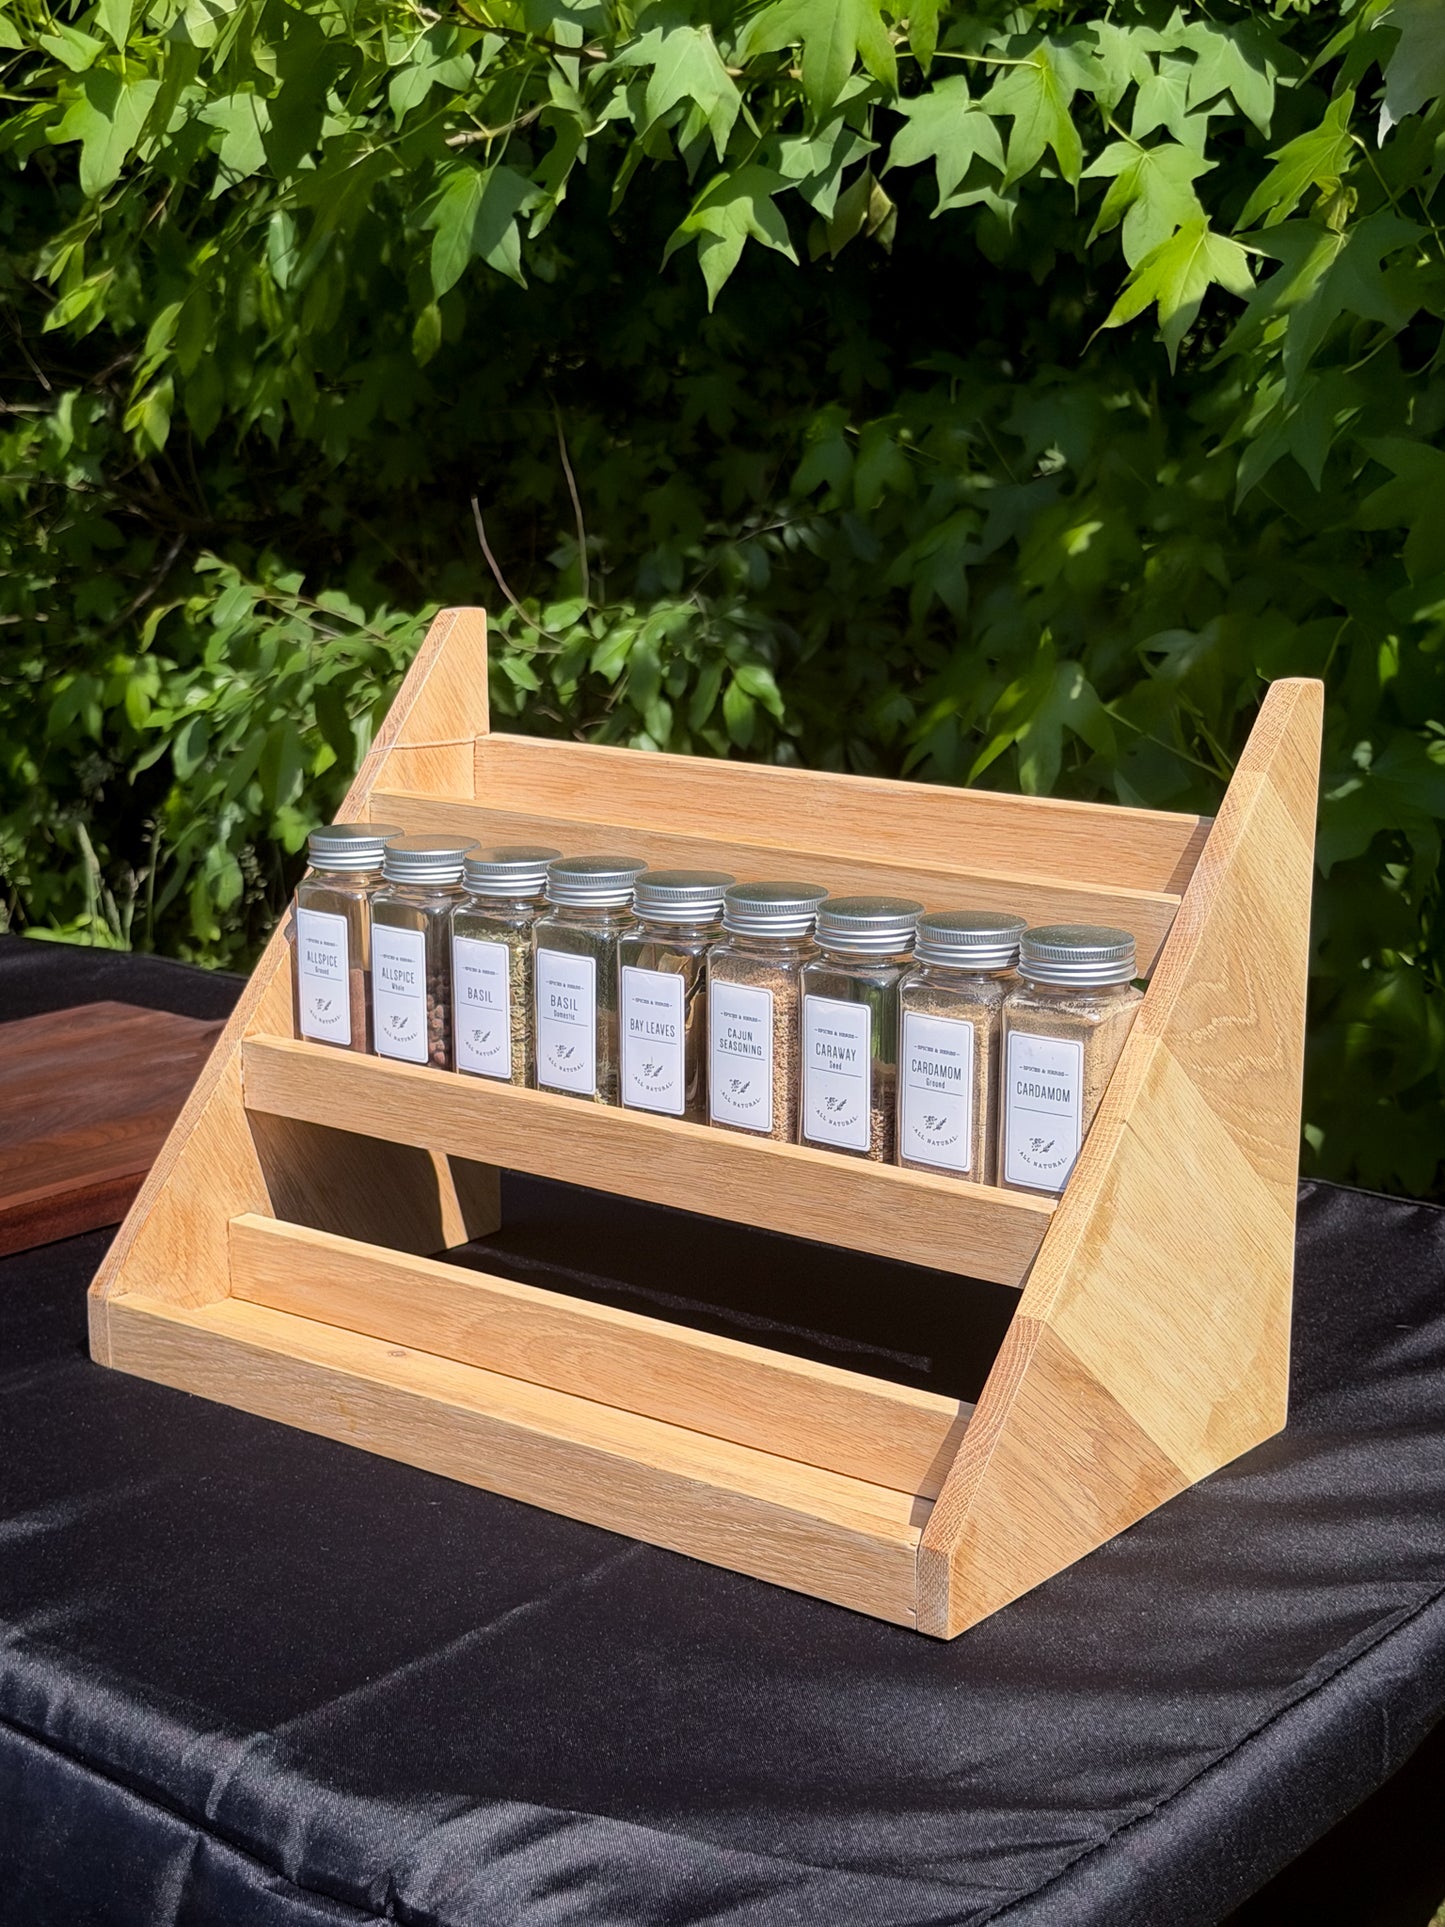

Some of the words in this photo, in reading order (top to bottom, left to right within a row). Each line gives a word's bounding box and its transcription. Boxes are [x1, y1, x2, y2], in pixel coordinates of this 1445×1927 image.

[307, 950, 338, 968] ALLSPICE
[382, 967, 415, 984] ALLSPICE
[467, 987, 493, 1003] BASIL
[550, 994, 578, 1011] BASIL
[553, 1009, 575, 1020] Domestic
[630, 1018, 644, 1033] BAY
[646, 1021, 675, 1038] LEAVES
[727, 1027, 753, 1042] CAJUN
[720, 1038, 762, 1056] SEASONING
[815, 1042, 856, 1061] CARAWAY
[829, 1060, 842, 1070] Seed
[911, 1059, 961, 1081] CARDAMOM
[926, 1078, 945, 1089] Ground
[1016, 1081, 1070, 1103] CARDAMOM
